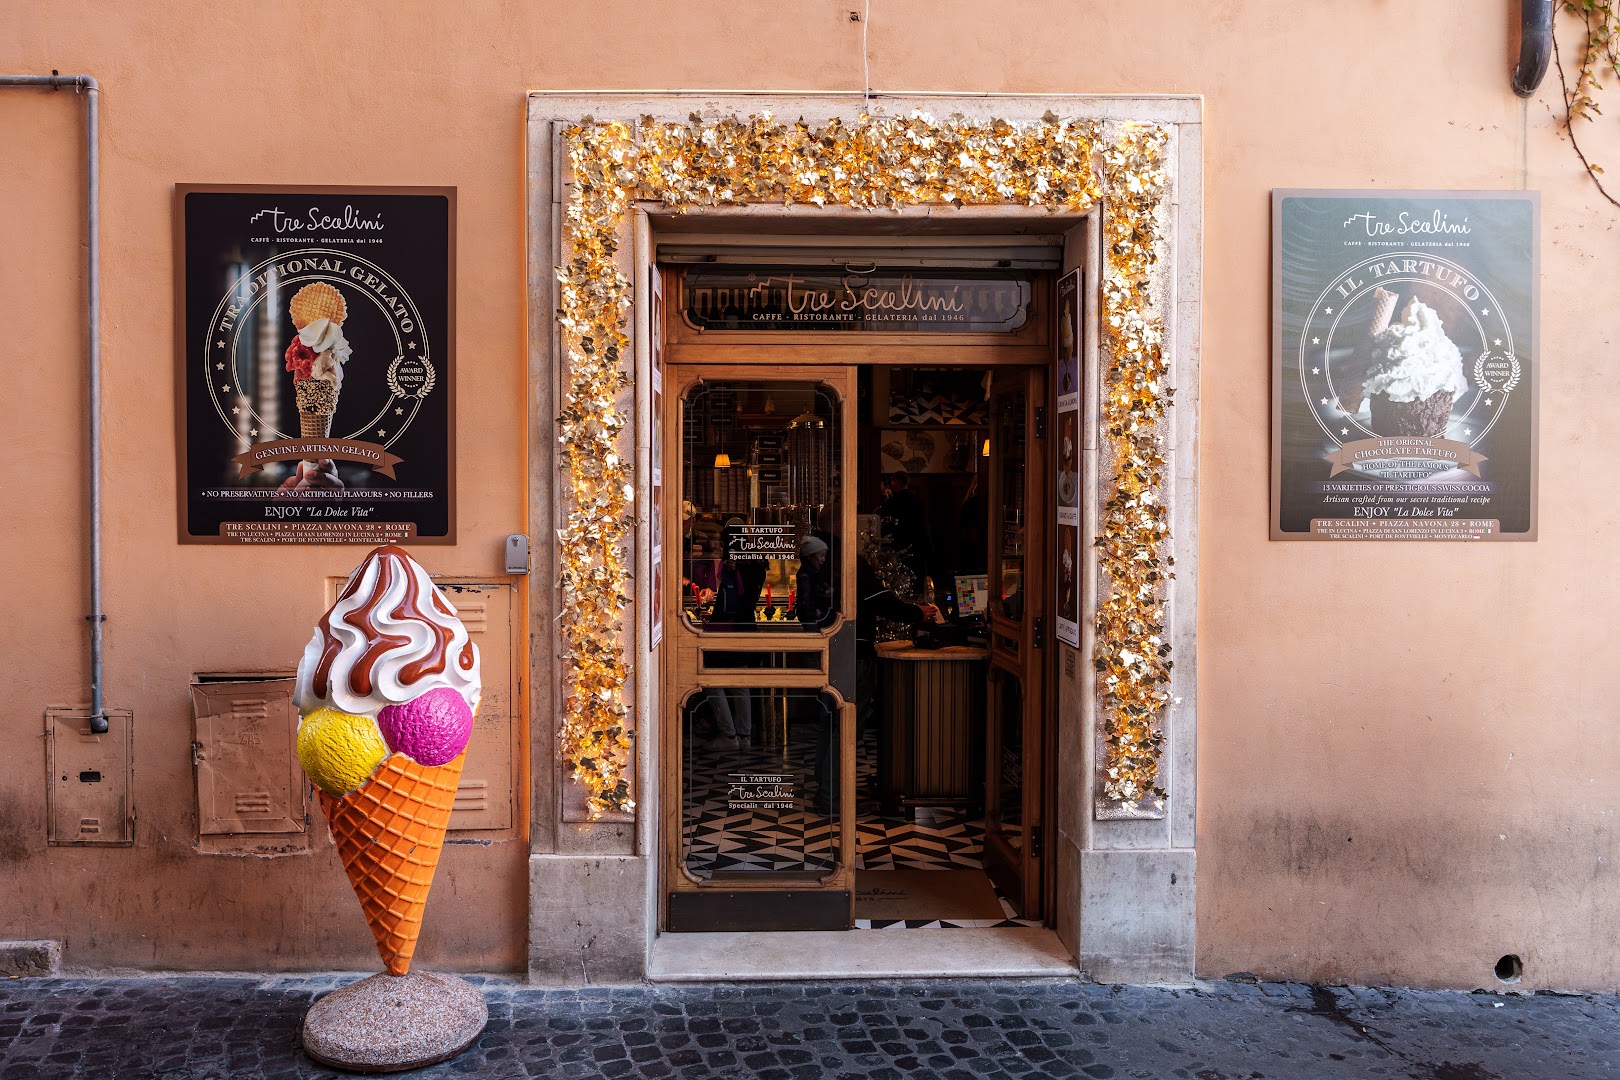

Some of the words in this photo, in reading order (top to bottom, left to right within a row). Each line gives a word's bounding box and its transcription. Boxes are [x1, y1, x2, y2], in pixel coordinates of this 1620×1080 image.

[251, 207, 304, 232] tre
[307, 205, 384, 230] Scalini
[1344, 211, 1395, 236] tre
[1398, 210, 1471, 234] Scalini
[1336, 276, 1364, 299] IL
[1369, 260, 1479, 300] TARTUFO
[219, 258, 347, 332] TRADITIONAL
[350, 266, 414, 334] GELATO
[750, 273, 836, 313] tre
[841, 272, 963, 311] Scalini
[255, 445, 298, 459] GENUINE
[341, 445, 380, 460] GELATO
[1355, 448, 1412, 459] CHOCOLATE
[1414, 448, 1456, 459] TARTUFO
[1362, 462, 1386, 470] HOME
[1417, 462, 1449, 471] FAMOUS
[1352, 495, 1375, 505] crafted
[1376, 496, 1393, 504] from
[1471, 496, 1490, 505] recipe
[265, 507, 302, 518] ENJOY
[306, 507, 322, 516] "La
[324, 507, 348, 516] Dolce
[351, 507, 374, 516] Vita"
[1354, 507, 1390, 518] ENJOY
[1394, 507, 1408, 516] "La
[1411, 507, 1434, 516] Dolce
[1437, 507, 1459, 516] Vita"
[729, 537, 756, 550] tre
[757, 536, 796, 549] Scalini
[240, 732, 263, 745] GAS
[728, 786, 755, 799] tre
[756, 785, 794, 798] Scalini
